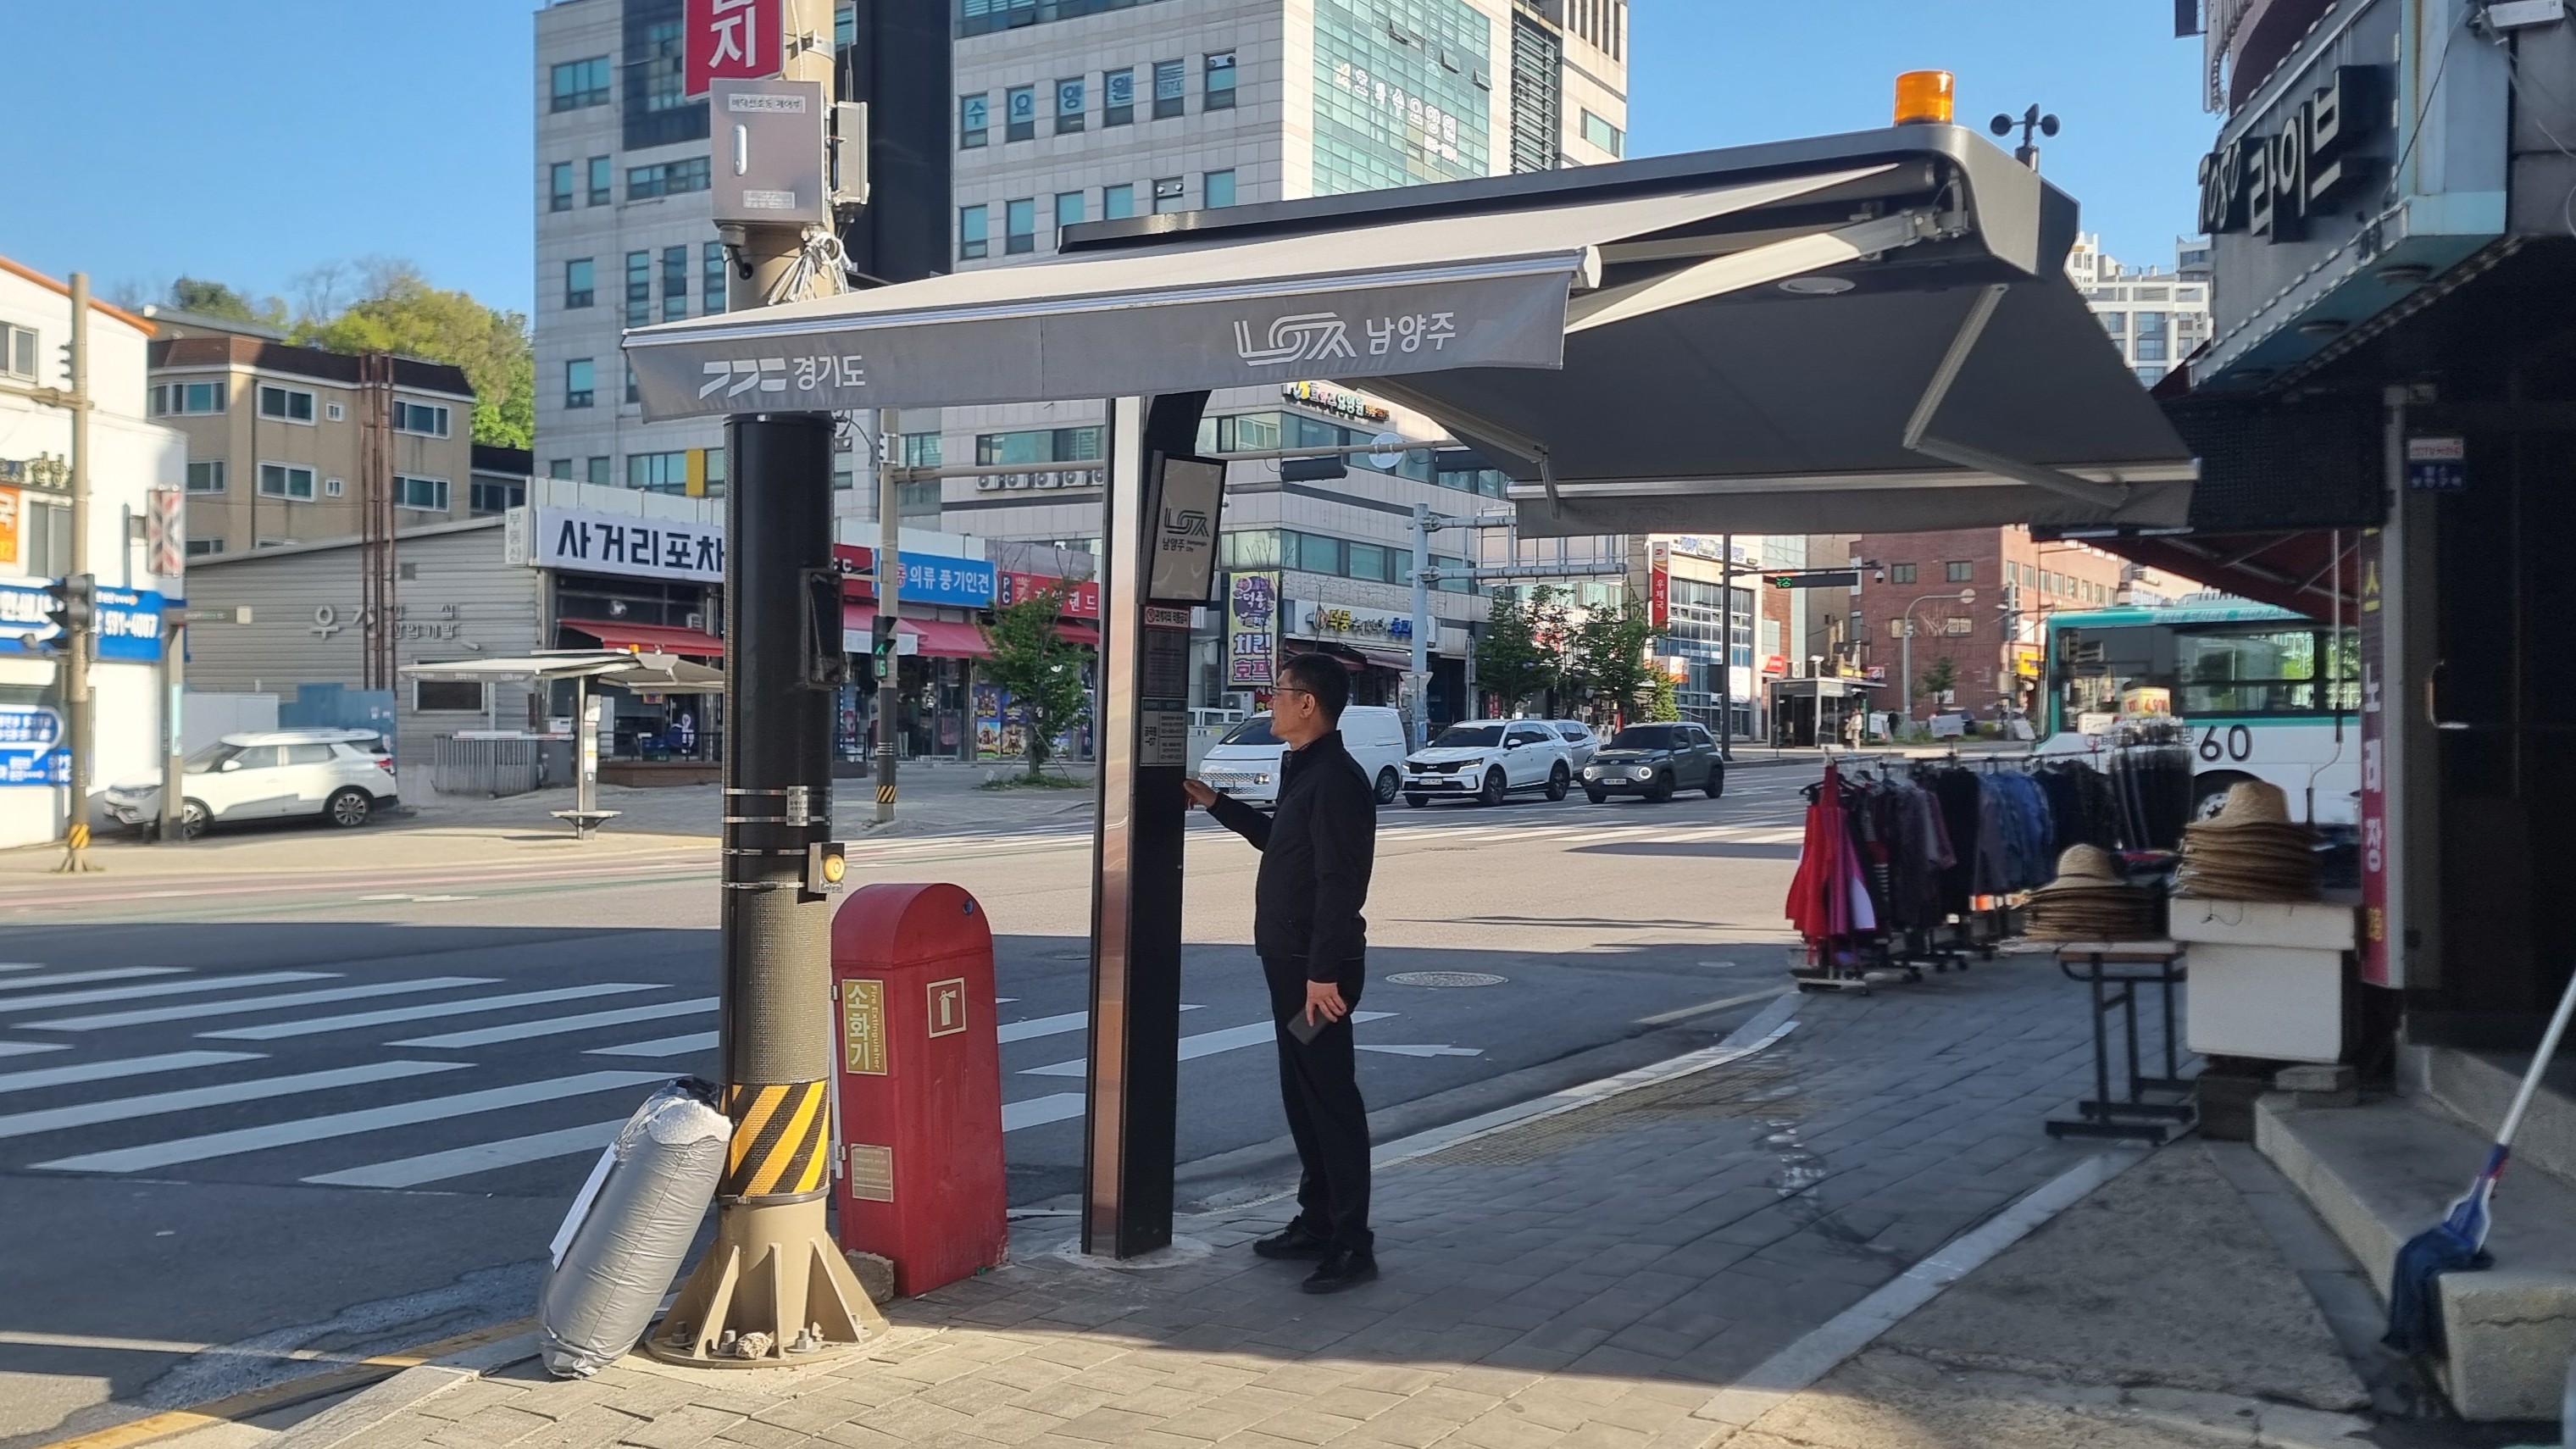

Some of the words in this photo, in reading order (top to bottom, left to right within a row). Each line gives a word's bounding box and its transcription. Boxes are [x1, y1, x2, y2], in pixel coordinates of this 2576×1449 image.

[2250, 66, 2340, 244] 라이브
[1366, 312, 1456, 355] 남양주
[793, 354, 866, 391] 경기도
[1163, 537, 1185, 552] 남양주
[909, 564, 936, 591] 의류
[939, 569, 989, 594] 풍기인견
[1655, 579, 1665, 610] 우체국
[1235, 634, 1272, 654] 치킨
[1234, 659, 1271, 681] 호프
[2199, 724, 2252, 762] 60
[847, 985, 870, 1070] 소화기
[871, 1007, 881, 1069] Extinguisher
